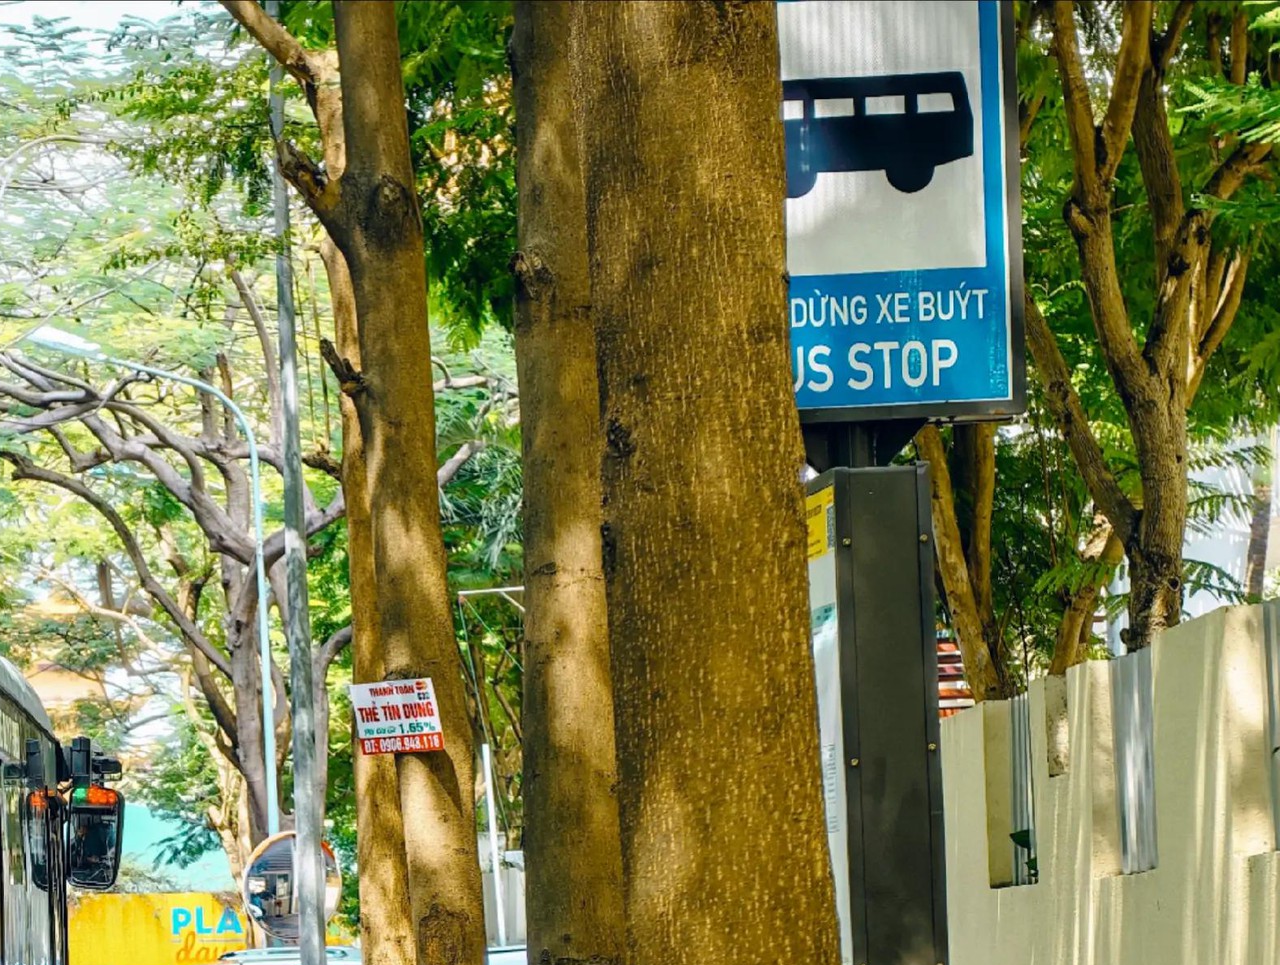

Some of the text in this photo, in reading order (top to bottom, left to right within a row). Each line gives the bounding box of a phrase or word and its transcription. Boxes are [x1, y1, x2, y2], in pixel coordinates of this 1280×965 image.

[791, 281, 989, 328] DỪNG XE BUÝT
[847, 339, 959, 391] STOP
[402, 701, 435, 722] DỤNG
